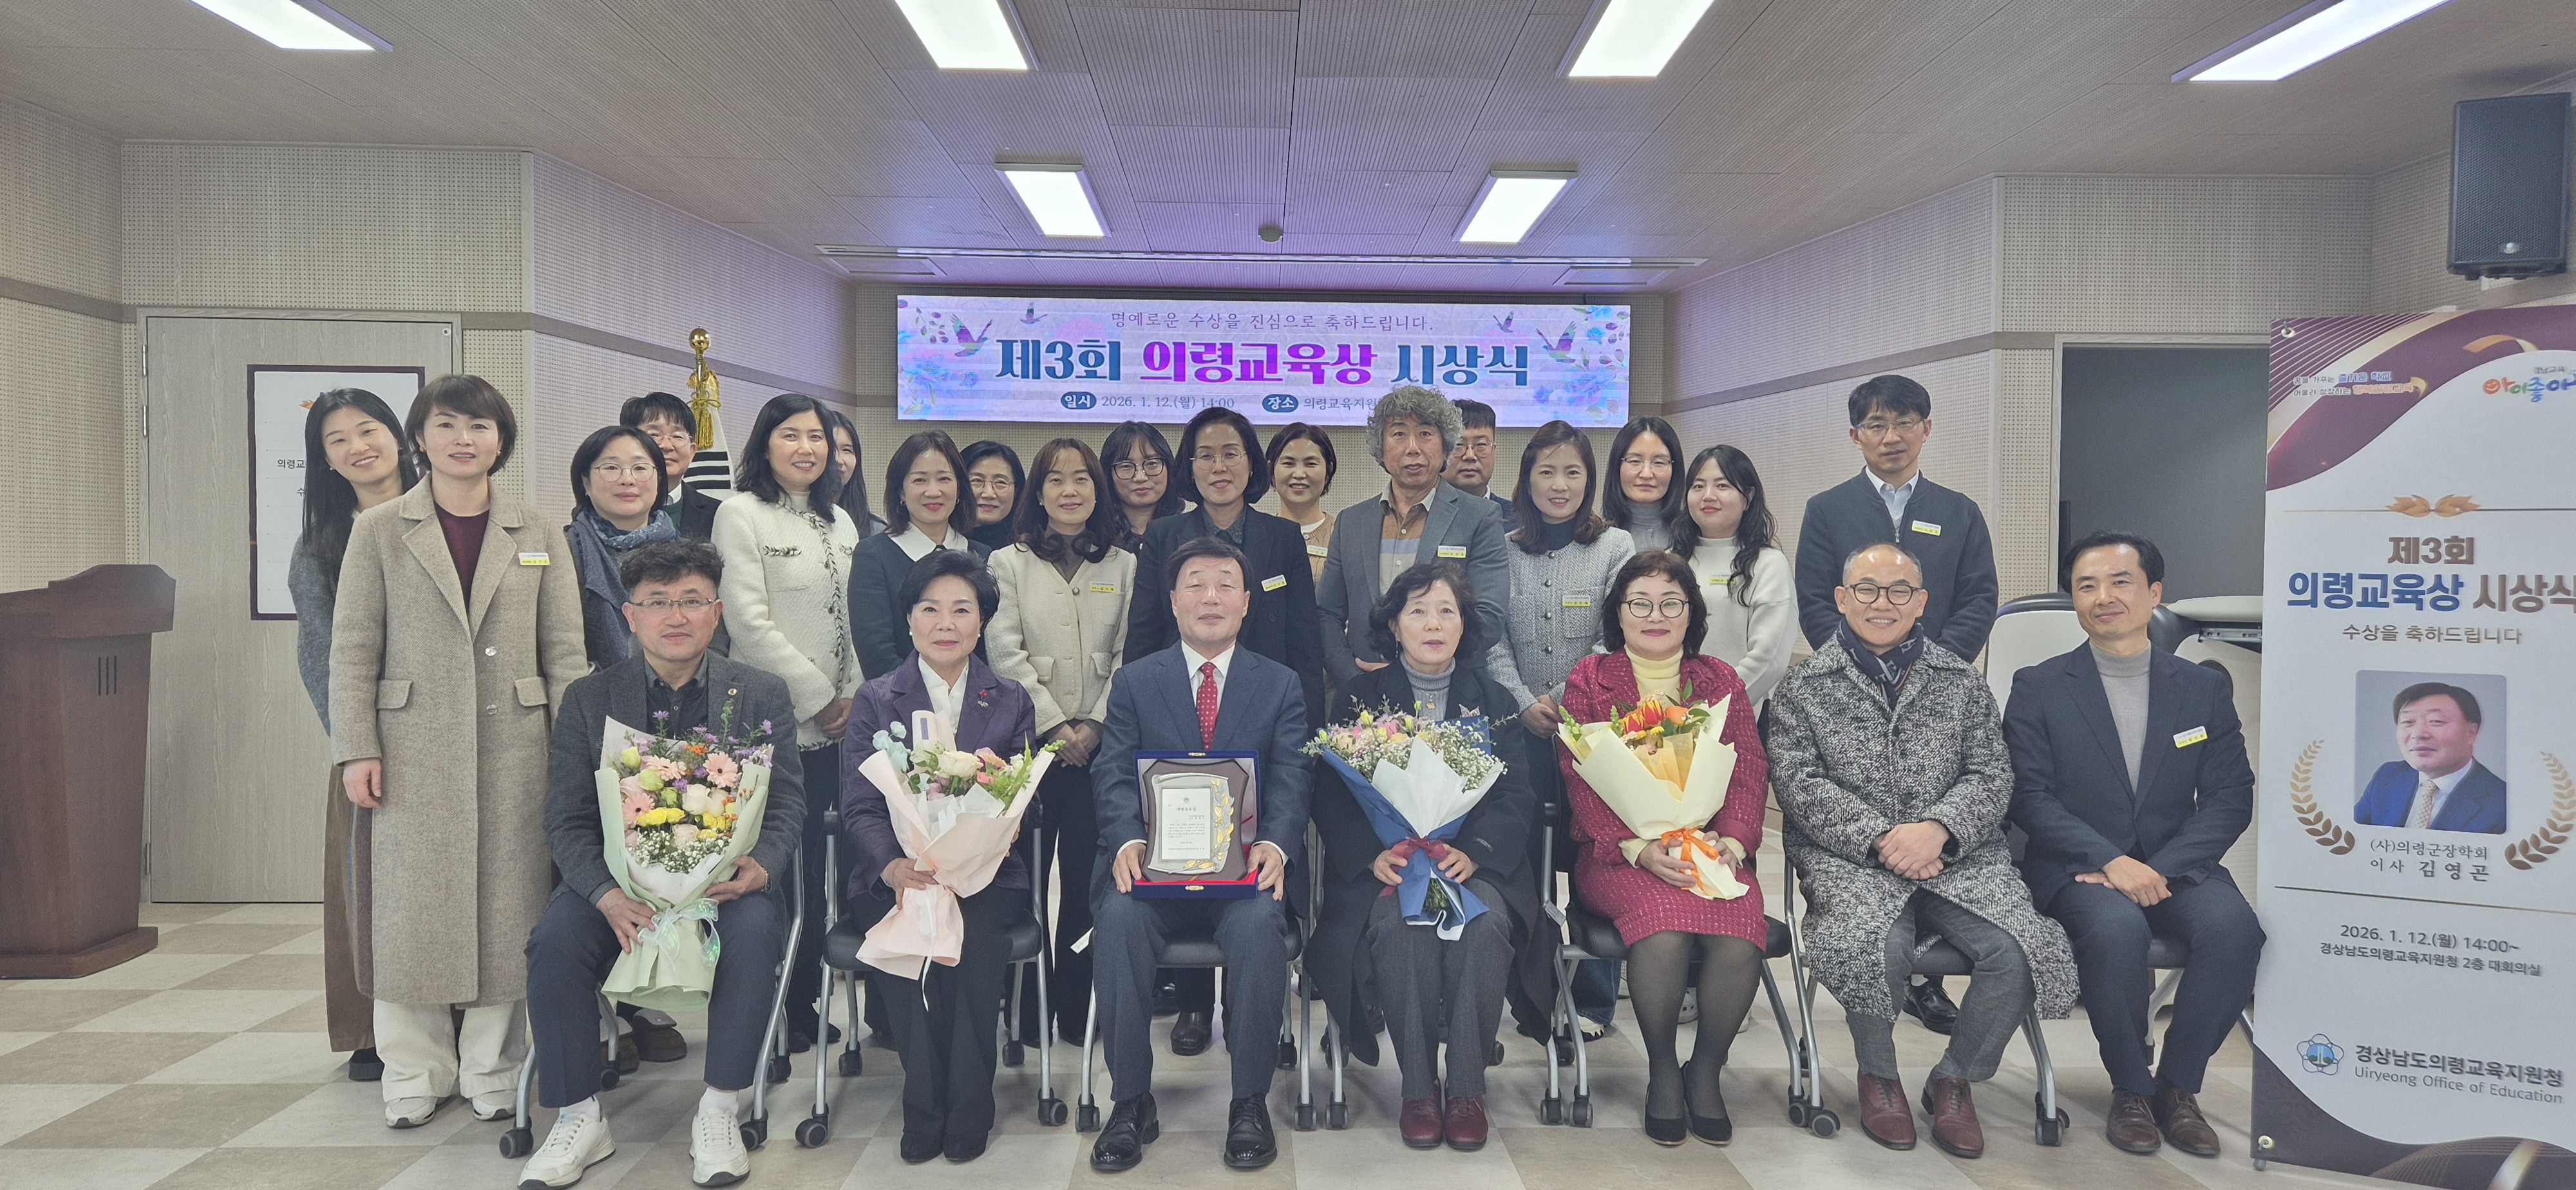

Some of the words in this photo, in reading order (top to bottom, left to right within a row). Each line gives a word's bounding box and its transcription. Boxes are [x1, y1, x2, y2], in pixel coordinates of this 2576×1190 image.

[1112, 312, 1179, 328] 명예로운
[1189, 313, 1240, 329] 수상을
[1251, 314, 1316, 330] 진심으로
[1325, 315, 1433, 332] 축하드립니다.
[996, 339, 1121, 381] 제3회
[1140, 341, 1378, 385] 의령교육상
[1390, 345, 1528, 386] 시상식
[2338, 372, 2367, 382] 즐거운
[2371, 371, 2391, 381] 학교
[1064, 393, 1092, 408] 일시
[1101, 396, 1136, 408] 2026.
[1141, 397, 1151, 408] 1.
[1156, 395, 1196, 410] 12.(월)
[1201, 397, 1235, 408] 14:00
[1268, 397, 1294, 409] 장소
[1303, 397, 1376, 411] 의령교육지원
[277, 458, 306, 469] 의령교
[2387, 535, 2474, 565] 제3회
[2287, 572, 2464, 612] 의령교육상
[2472, 574, 2576, 613] 시상식
[2342, 623, 2398, 642] 수상을
[2405, 625, 2523, 645] 축하드립니다
[2370, 838, 2488, 861] (사)의령군장학회
[2340, 925, 2383, 941] 2026.
[2389, 929, 2402, 943] 1.
[2407, 931, 2458, 950] 12.(월)
[2463, 936, 2519, 953] 14:00~
[2320, 942, 2458, 968] 경상남도의령교육지원청
[2462, 957, 2484, 971] 2층
[2488, 959, 2543, 977] 대회의실
[2355, 1044, 2564, 1088] 경상남도의령교육지원청
[2355, 1066, 2418, 1087] Uiryeong
[2423, 1075, 2463, 1091] Office
[2469, 1081, 2485, 1093] of
[2490, 1083, 2564, 1104] Education
